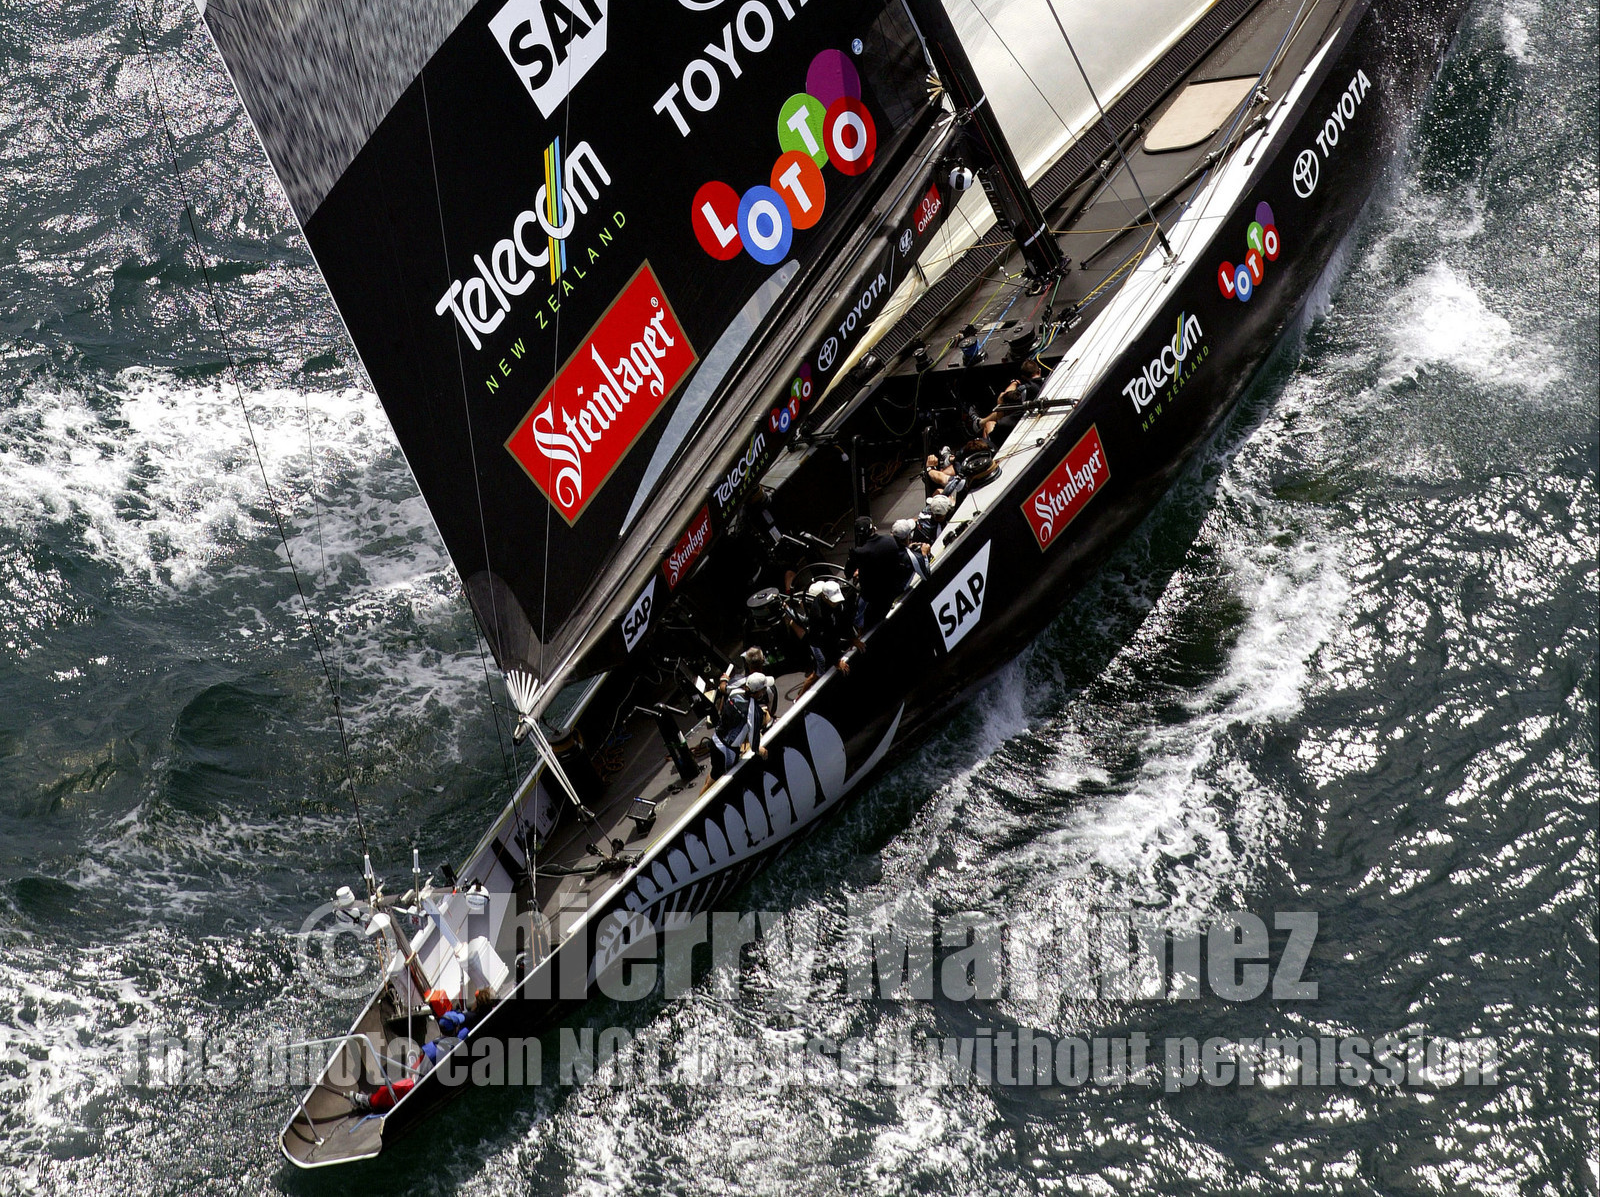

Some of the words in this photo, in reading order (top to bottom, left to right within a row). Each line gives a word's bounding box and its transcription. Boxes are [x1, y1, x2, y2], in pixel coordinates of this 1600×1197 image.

[1315, 69, 1372, 158] TOYOTA
[701, 104, 867, 251] LOTTO
[918, 198, 942, 232] OMEGA
[435, 139, 612, 351] Telecom
[1221, 226, 1278, 296] LOTTO
[486, 337, 528, 394] NEW
[535, 210, 627, 330] ZEALAND
[838, 272, 887, 340] TOYOTA
[1122, 313, 1203, 414] Telecom
[1142, 404, 1163, 432] NEW
[1167, 345, 1210, 402] ZEALAND
[532, 307, 675, 508] Steinlager
[713, 432, 765, 508] Telecom
[722, 499, 736, 518] NEW
[1035, 447, 1102, 543] Steinlager
[669, 517, 710, 586] Steinlager
[623, 595, 651, 645] SAP
[939, 571, 985, 638] SAP
